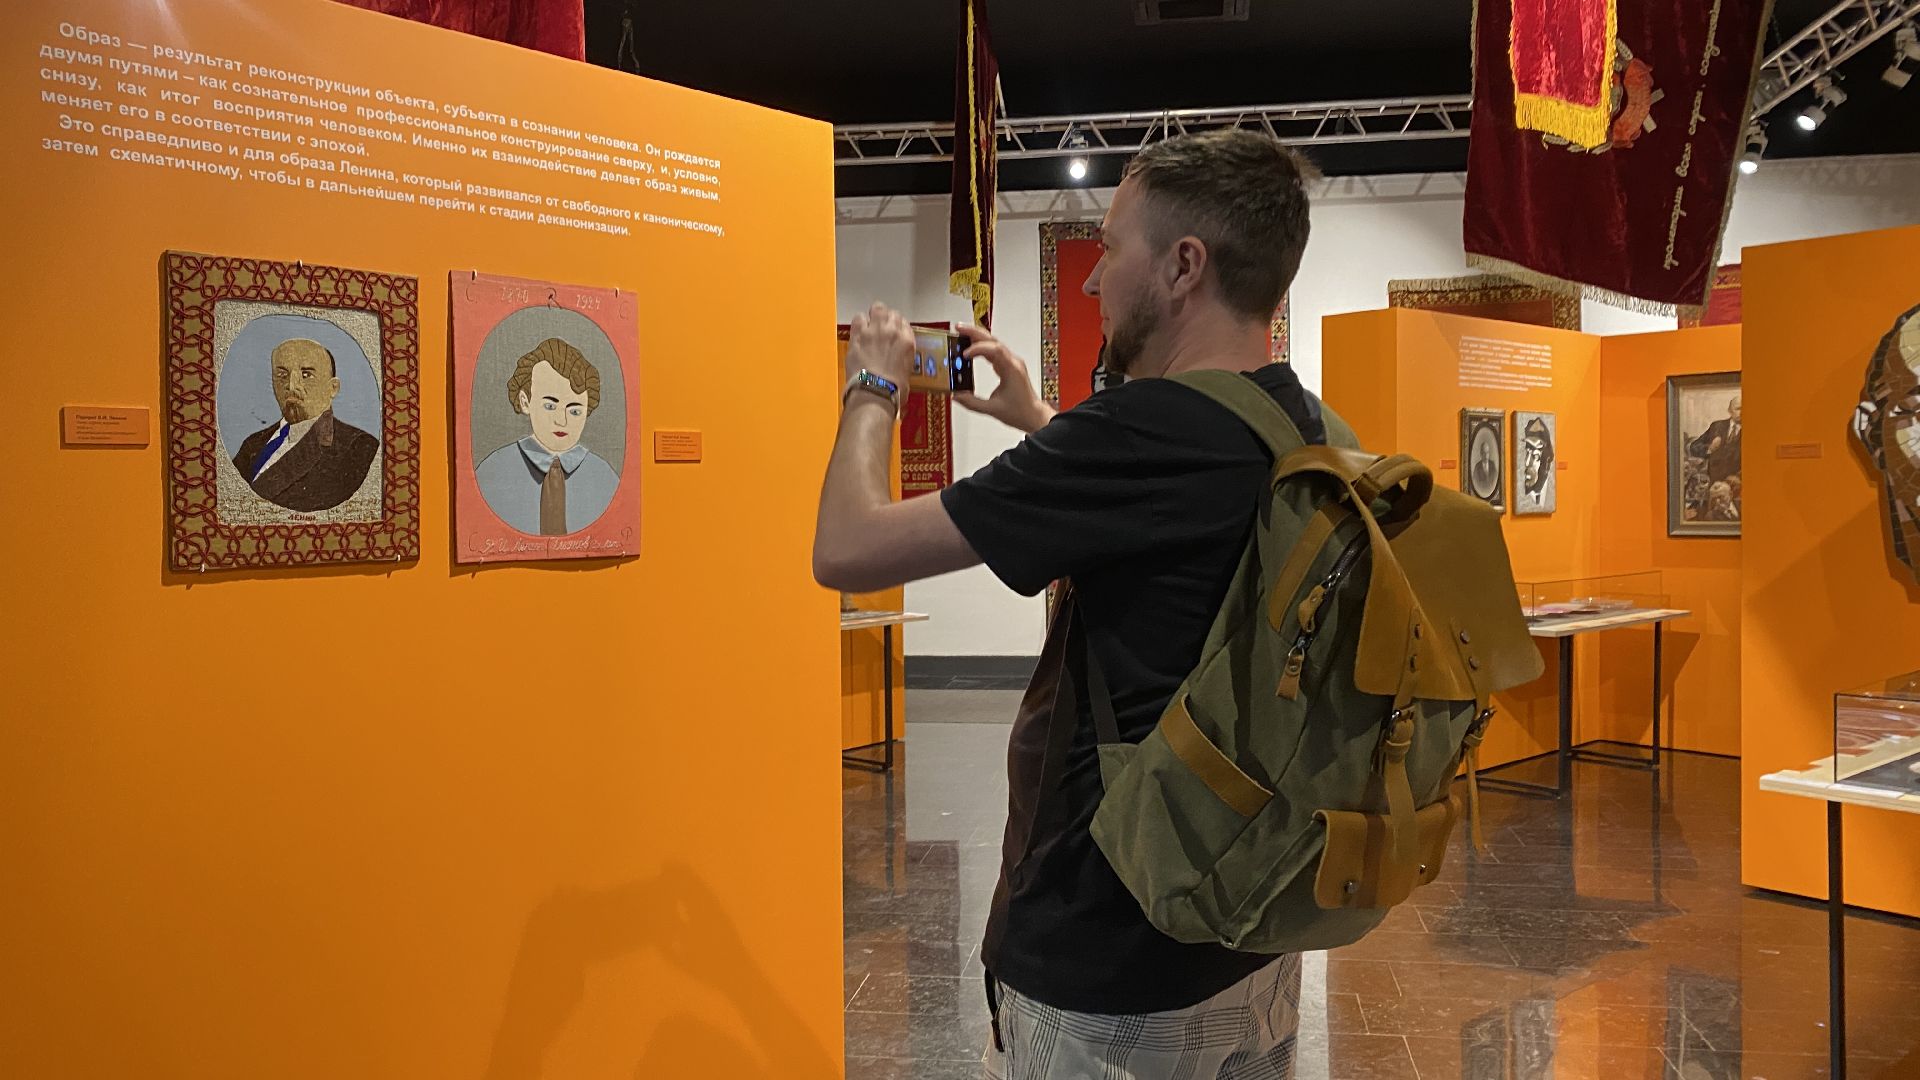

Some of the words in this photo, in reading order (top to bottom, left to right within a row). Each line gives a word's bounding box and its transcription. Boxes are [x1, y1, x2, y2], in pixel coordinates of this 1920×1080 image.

[39, 43, 103, 67] двумя
[109, 57, 179, 81] путями
[199, 74, 228, 91] как
[231, 81, 348, 113] сознательное
[356, 105, 498, 142] профессиональное
[500, 133, 610, 164] конструирование
[612, 156, 655, 175] сверху,
[660, 165, 671, 177] и,
[673, 168, 721, 187] условно,
[40, 67, 102, 91] снизу,
[117, 80, 147, 97] как
[160, 89, 201, 106] итог
[213, 99, 314, 127] восприятия
[319, 118, 407, 144] человеком.
[412, 132, 467, 155] Именно
[471, 146, 488, 159] их
[492, 150, 597, 179] взаимодействие
[600, 170, 641, 186] делает
[644, 172, 678, 193] образ
[680, 185, 721, 202] живым,
[41, 89, 113, 113] меняет
[118, 103, 149, 120] его
[155, 109, 166, 122] в
[171, 113, 292, 144] соответствии
[296, 135, 306, 146] с
[309, 137, 370, 157] эпохой.
[59, 22, 121, 48] Образ
[153, 44, 243, 72] результат
[248, 64, 371, 98] реконструкции
[375, 89, 439, 114] объекта,
[443, 103, 506, 126] субъекта
[510, 117, 519, 128] в
[521, 119, 581, 141] сознании
[584, 132, 642, 153] человека.
[645, 143, 661, 157] Он
[663, 149, 721, 170] рождается
[41, 138, 99, 157] затем
[109, 147, 243, 181] схематичному,
[248, 169, 301, 187] чтобы
[305, 177, 315, 189] в
[319, 179, 415, 204] дальнейшем
[419, 194, 476, 213] перейти
[479, 203, 486, 214] к
[489, 206, 535, 222] стадии
[537, 212, 631, 236] деканонизации.
[59, 113, 95, 133] Это
[100, 124, 223, 154] справедливо
[228, 144, 239, 157] и
[242, 147, 275, 162] для
[279, 151, 336, 172] образа
[339, 159, 399, 184] Ленина,
[402, 173, 463, 192] который
[466, 183, 542, 205] развивался
[545, 196, 560, 208] от
[561, 199, 631, 220] свободного
[633, 211, 641, 221] к
[642, 212, 725, 237] каноническому,
